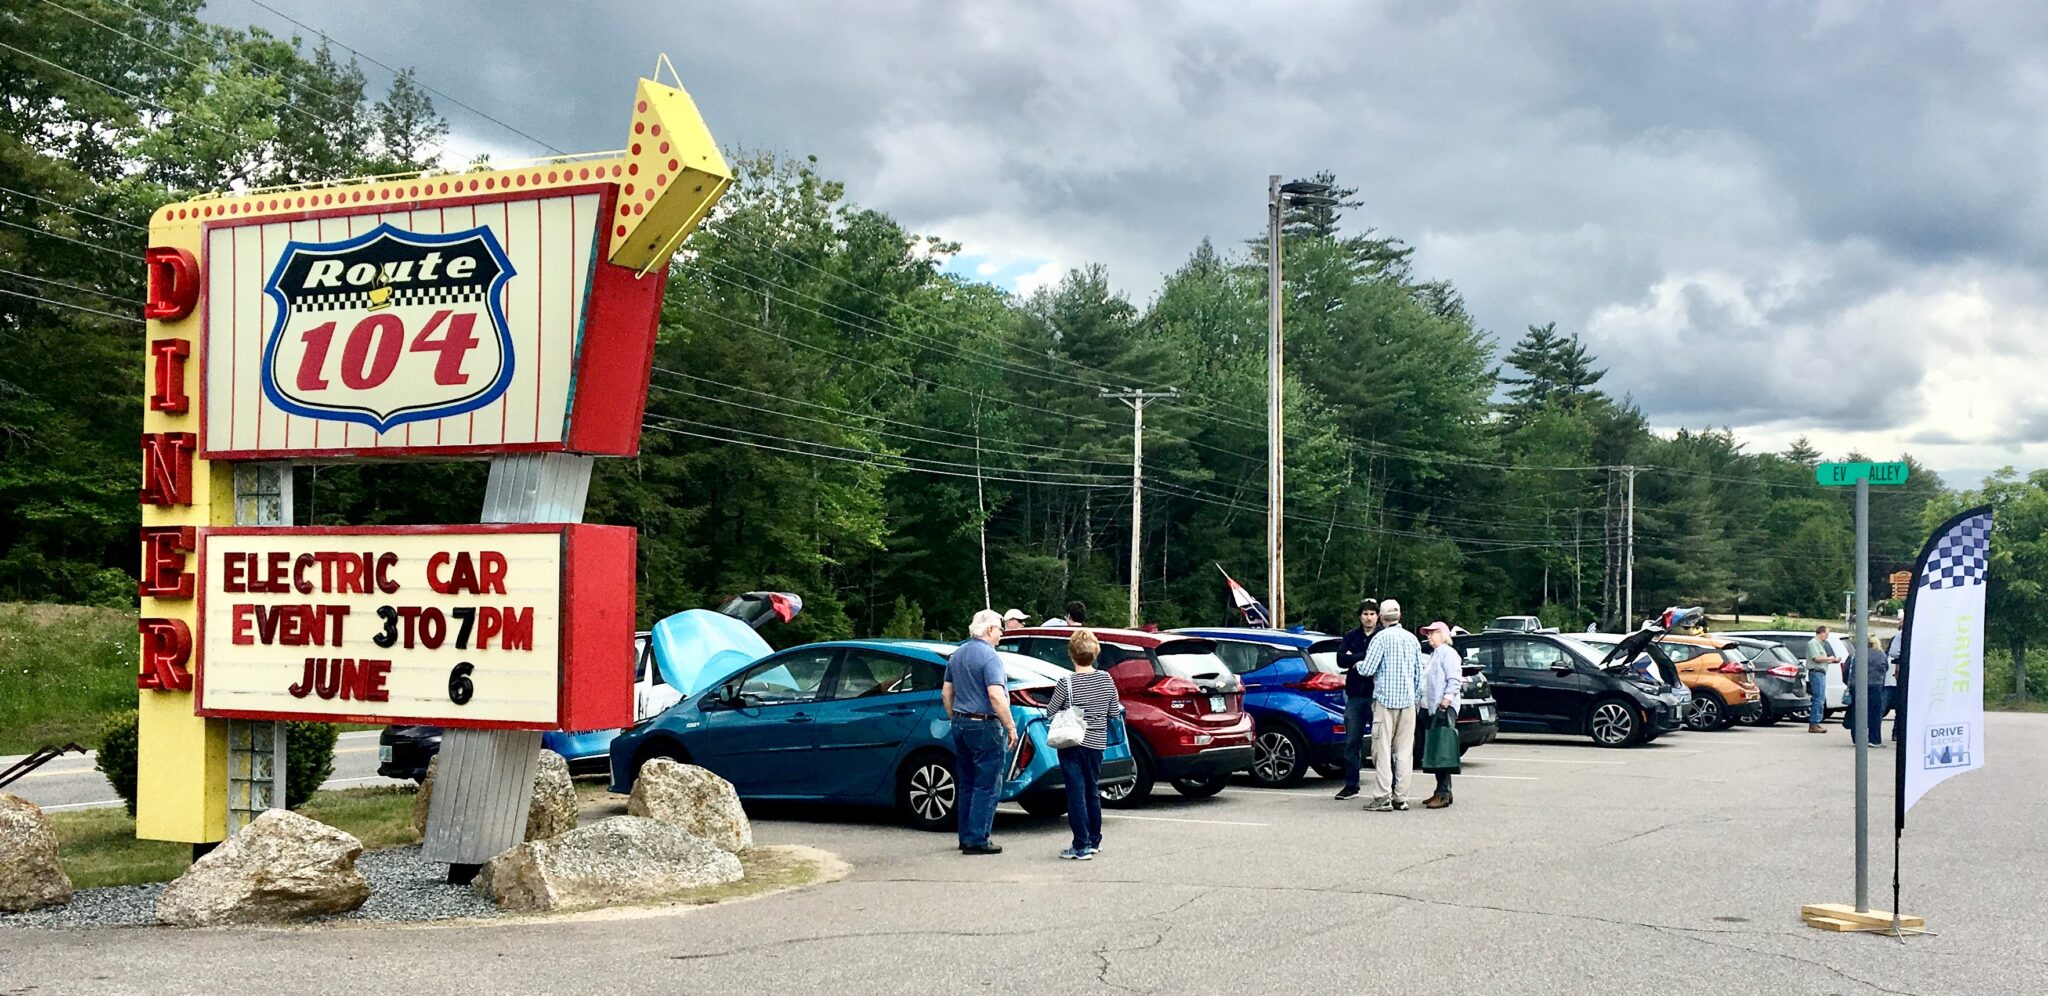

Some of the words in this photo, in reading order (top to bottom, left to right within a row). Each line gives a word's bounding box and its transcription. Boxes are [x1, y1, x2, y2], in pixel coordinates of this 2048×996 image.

[302, 252, 477, 289] Route
[296, 310, 479, 391] 104
[138, 246, 200, 692] DINER
[1833, 466, 1847, 482] EV
[1868, 465, 1901, 481] ALLEY
[223, 551, 400, 594] ELECTRIC
[426, 551, 507, 594] CAR
[231, 604, 350, 647] EVENT
[1952, 615, 1973, 693] DRIVE
[288, 657, 392, 702] JUNE
[447, 661, 475, 706] 6
[1930, 726, 1964, 738] DRIVE
